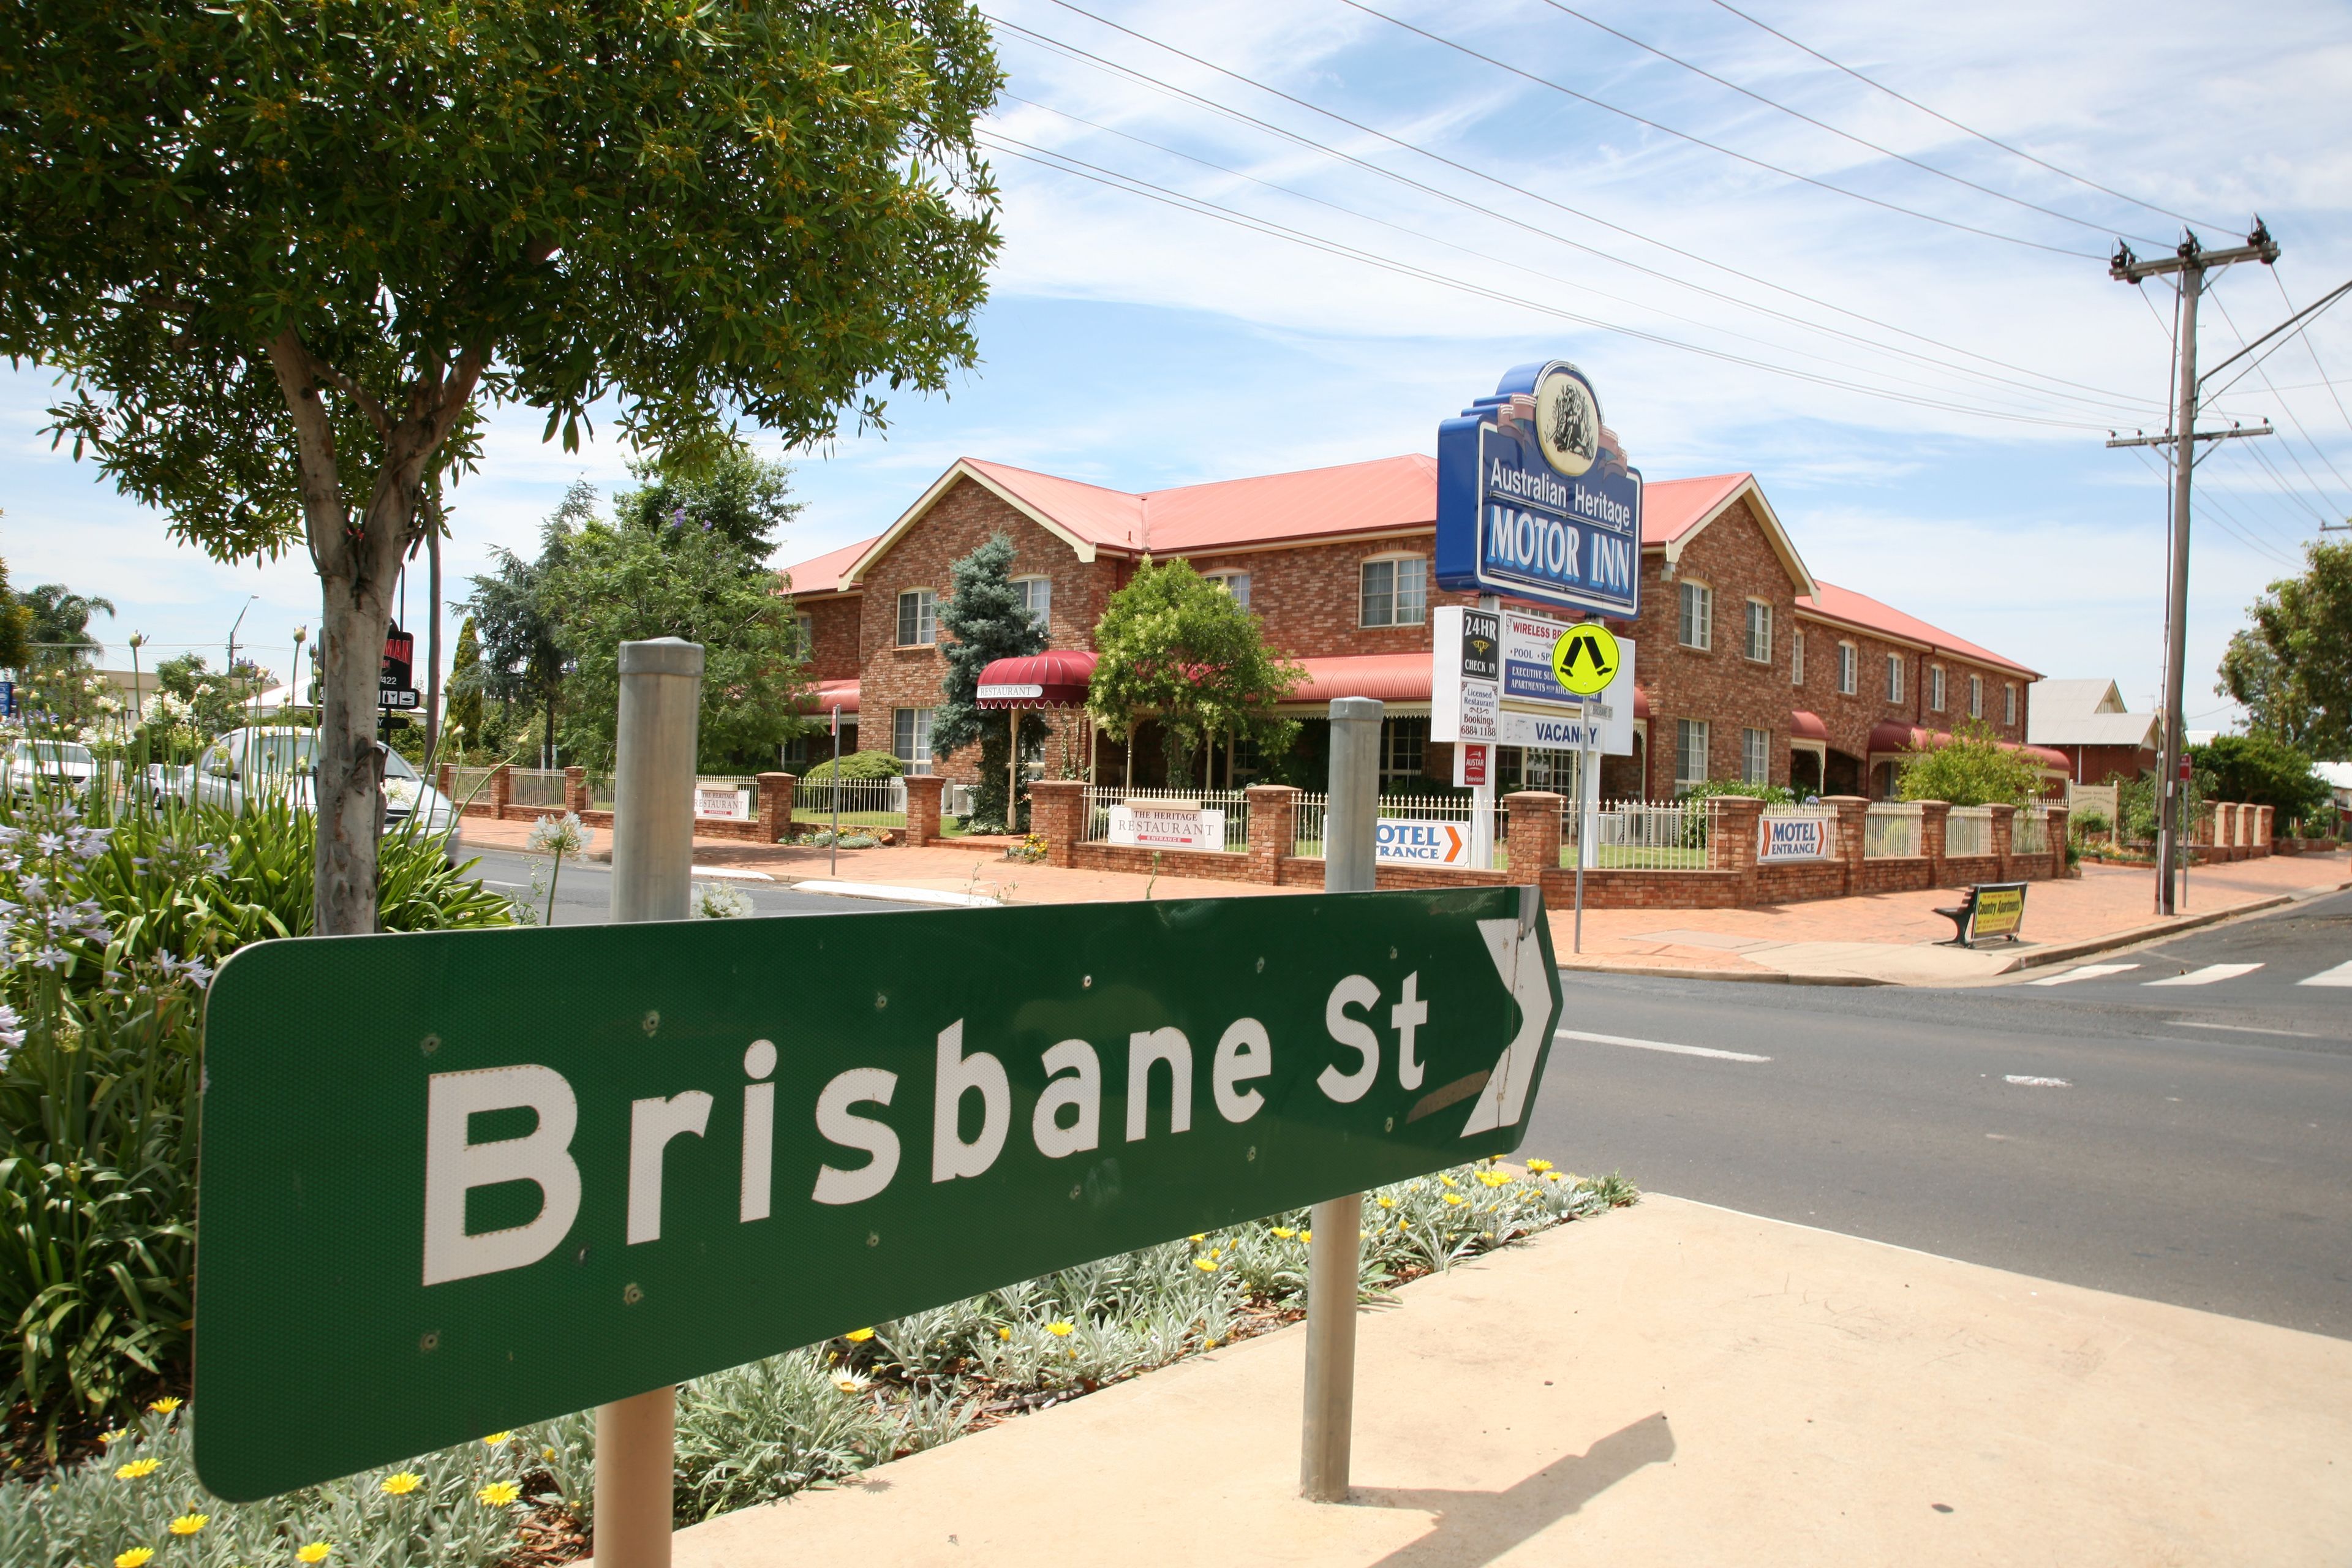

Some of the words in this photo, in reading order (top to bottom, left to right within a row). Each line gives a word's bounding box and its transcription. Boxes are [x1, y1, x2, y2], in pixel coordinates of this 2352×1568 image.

[1490, 457, 1567, 508] Australian
[1575, 483, 1630, 532] Heritage
[1487, 505, 1580, 581] MOTOR
[1589, 532, 1630, 594] INN
[1464, 615, 1497, 642] 24HR
[1513, 621, 1550, 639] WIRELESS
[1513, 647, 1533, 659] POOL
[1464, 658, 1486, 673] CHECK
[1488, 662, 1496, 674] IN
[1512, 666, 1542, 680] EXECUTIVE
[980, 687, 1032, 696] RESTAURANT
[1510, 679, 1545, 692] APARTMENTS
[1467, 688, 1492, 699] Licensed
[1464, 697, 1494, 707] Restaurant
[1464, 714, 1494, 727] Bookings
[1461, 725, 1477, 736] 6884
[1479, 726, 1496, 737] 1188
[1536, 722, 1597, 745] VACANY
[1466, 758, 1484, 766] AUSTAR
[694, 799, 744, 809] RESTAURANT
[1134, 810, 1151, 819] THE
[1154, 812, 1198, 821] HERITAGE
[1118, 820, 1215, 836] RESTAURANT
[1376, 824, 1441, 846] OTEL
[1772, 823, 1816, 842] MOTEL
[1771, 843, 1815, 855] ENTRANCE
[1978, 901, 1997, 916] Country
[423, 1018, 1273, 1287] Brisbane
[1316, 970, 1428, 1103] St
